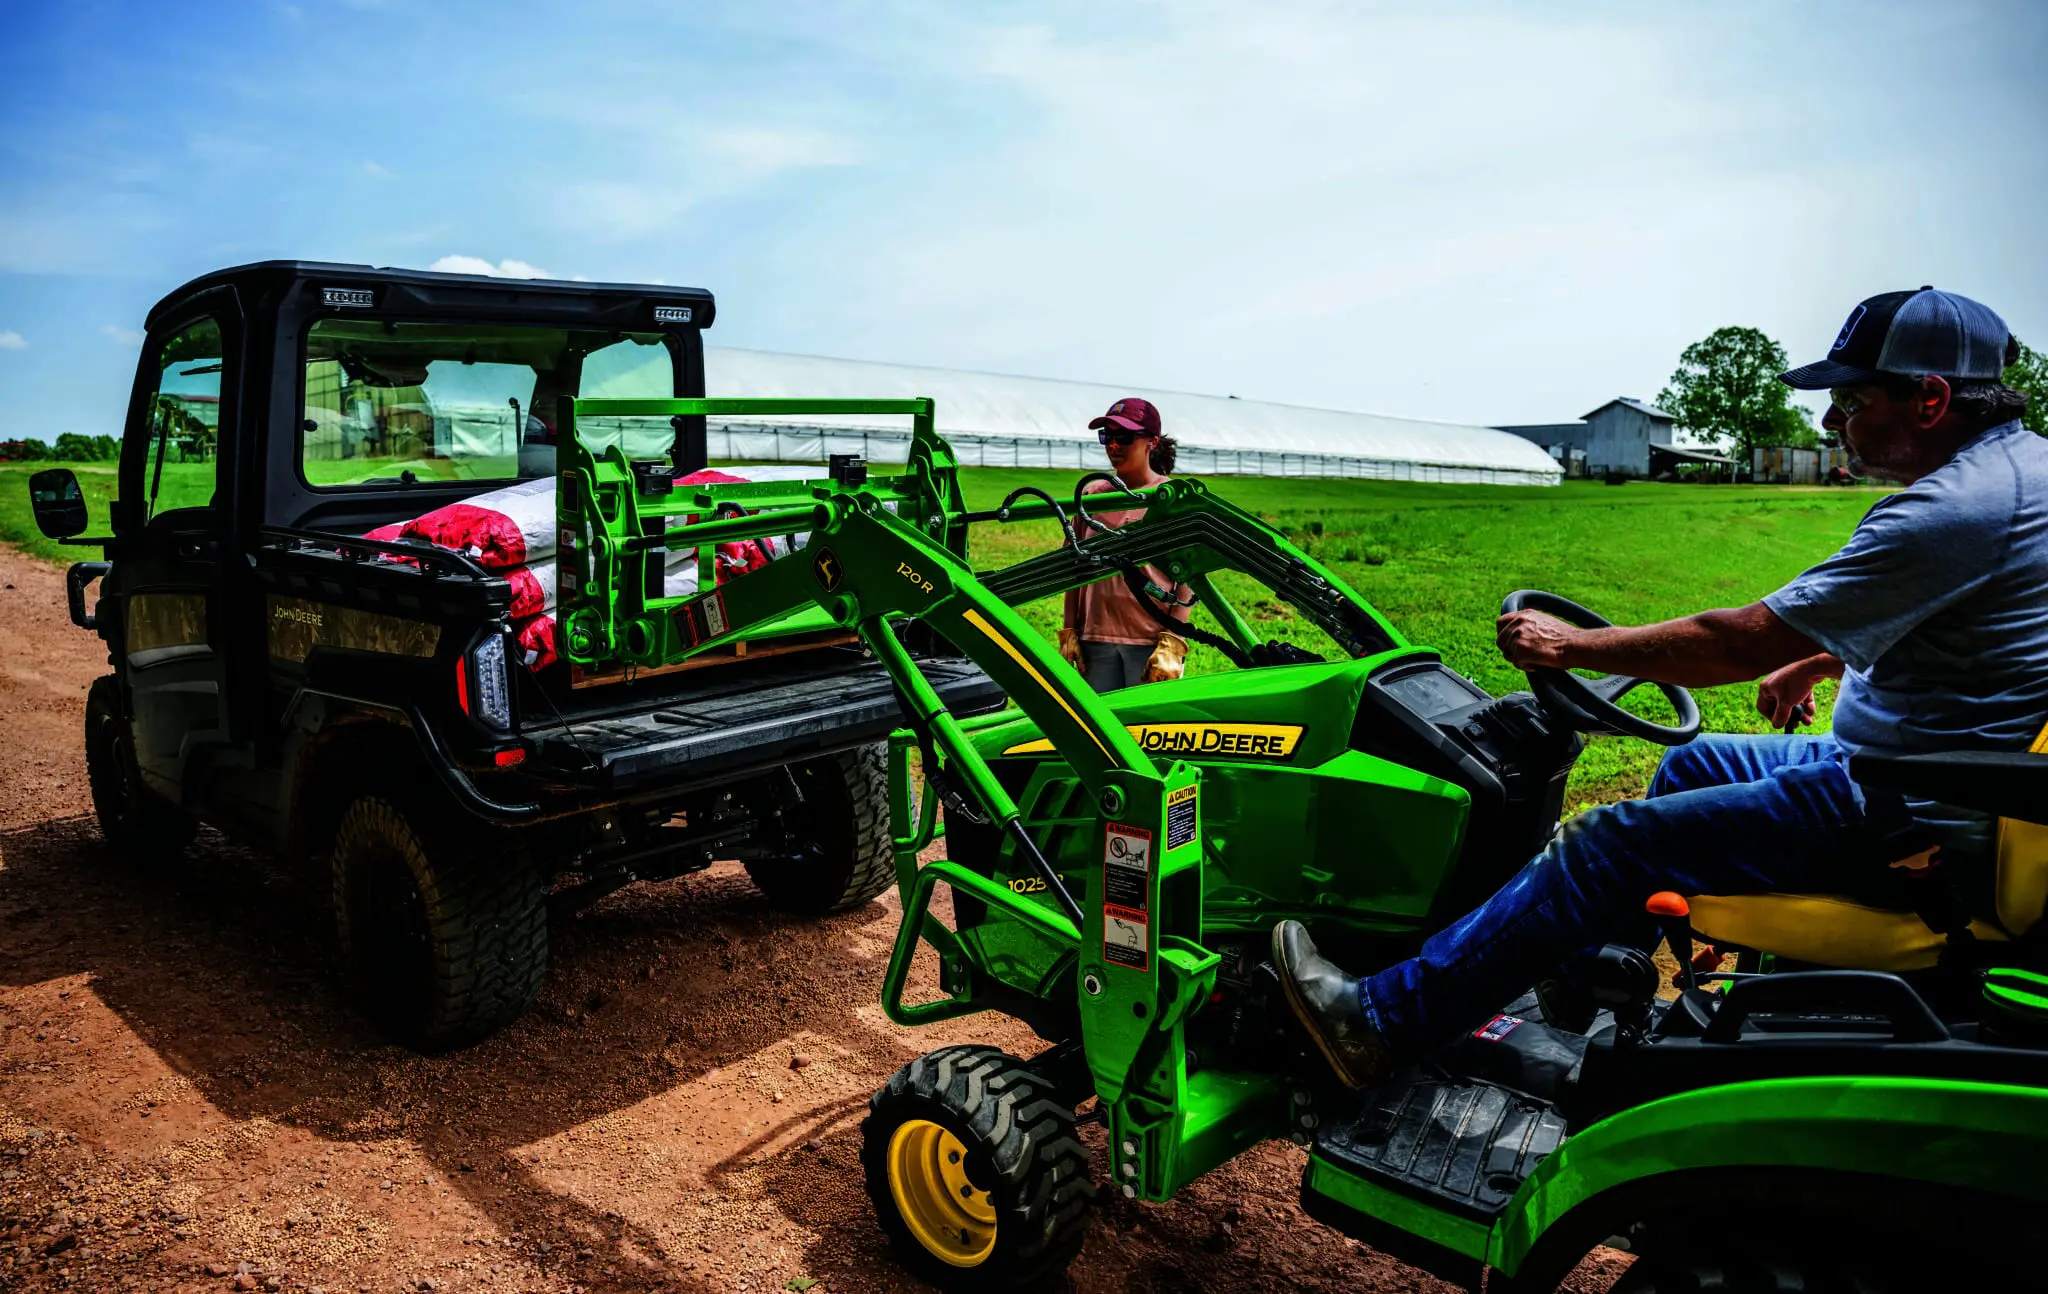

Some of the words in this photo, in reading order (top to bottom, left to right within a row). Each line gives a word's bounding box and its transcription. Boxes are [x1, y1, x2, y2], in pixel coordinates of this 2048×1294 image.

[274, 604, 295, 620] JOHN
[295, 608, 323, 626] DEERE
[1139, 728, 1197, 751] JOHN
[1201, 729, 1285, 755] DEERE
[1175, 786, 1196, 800] CAUTION
[1008, 874, 1064, 893] 1025
[1111, 907, 1146, 922] WARNING
